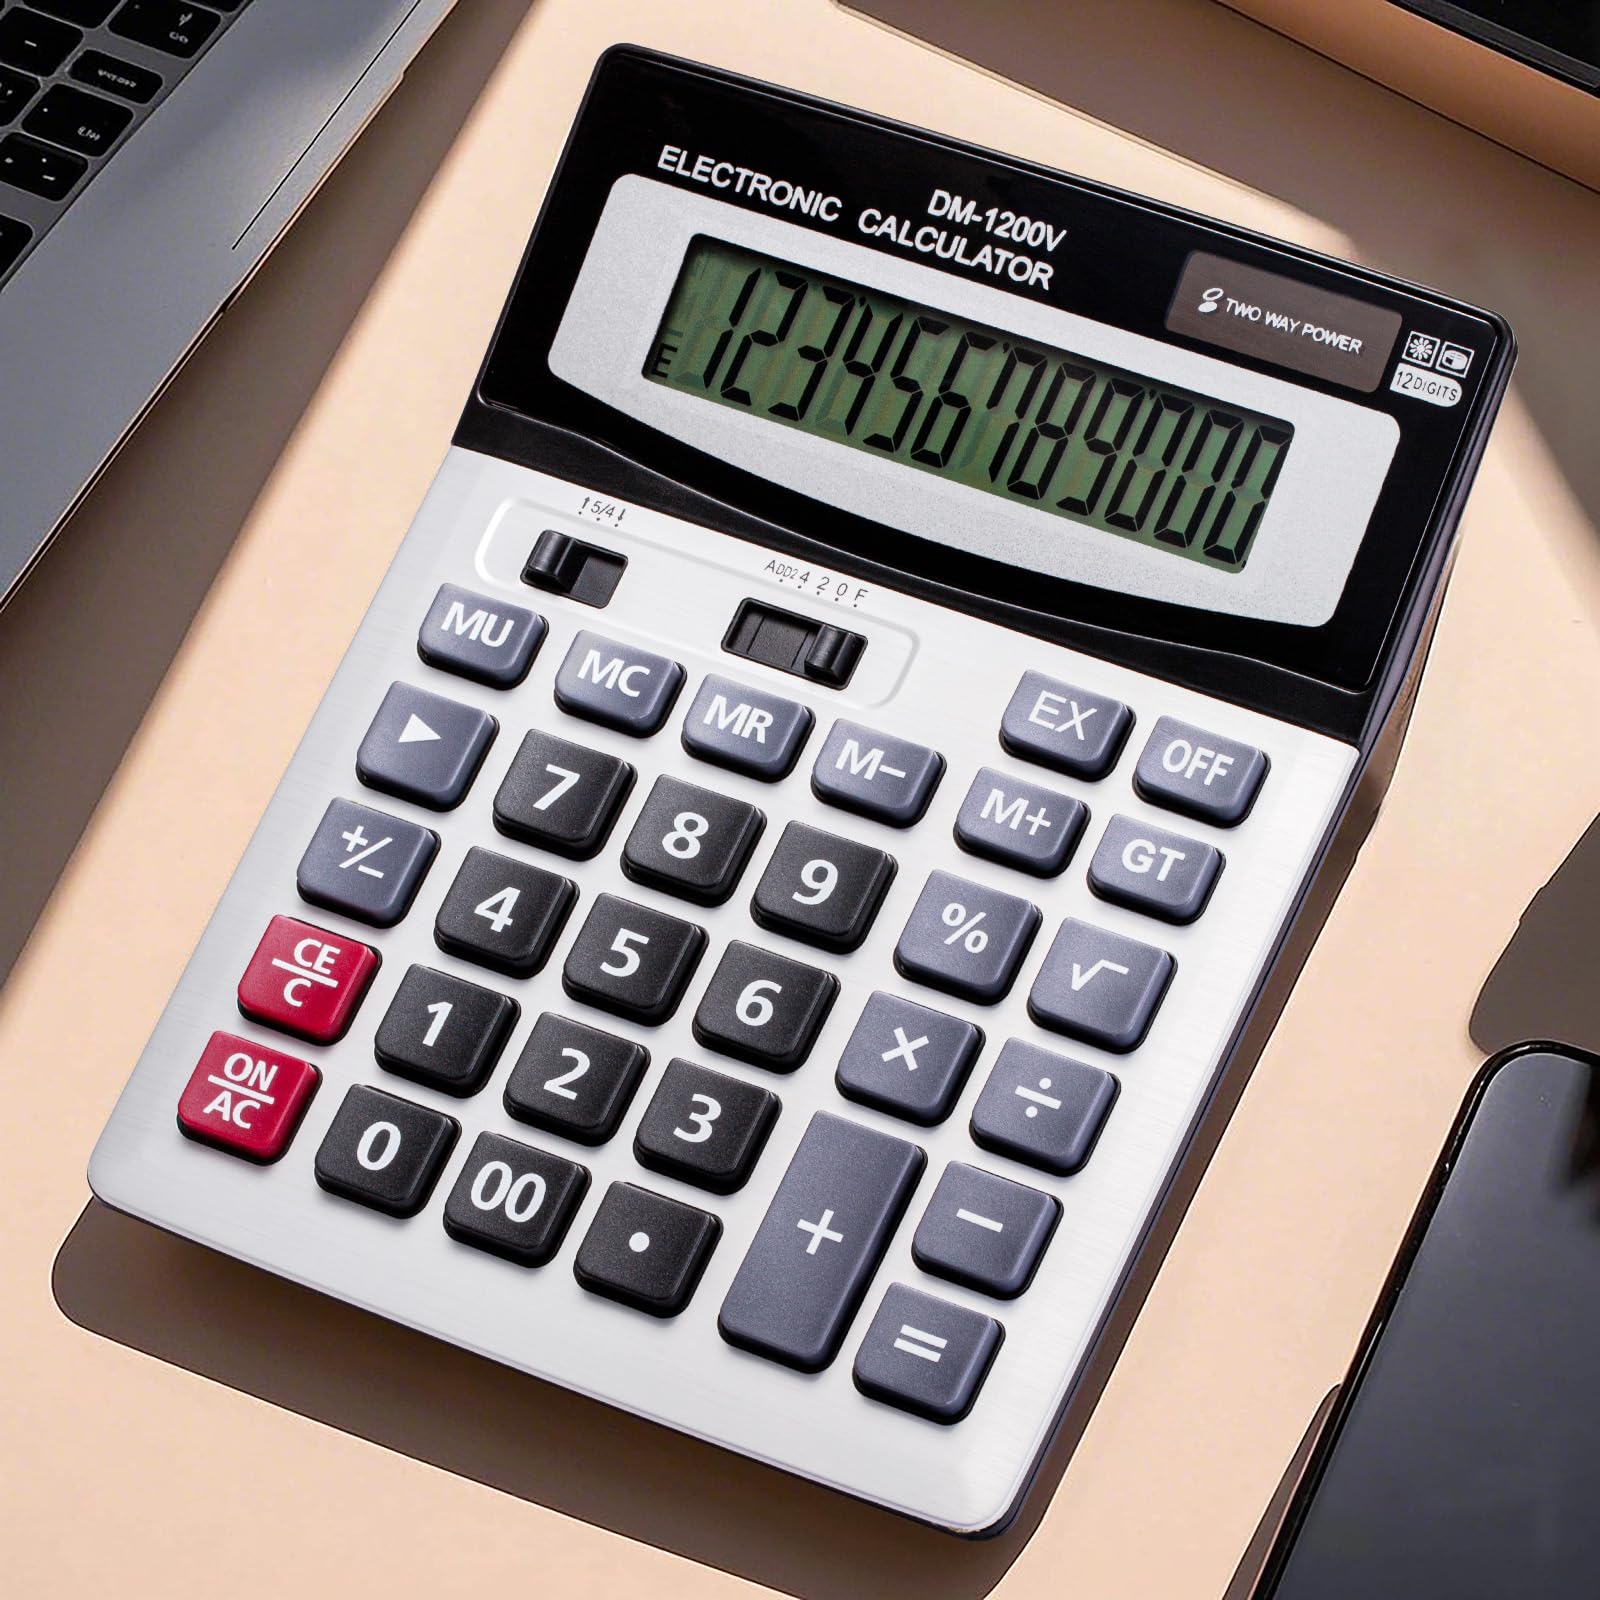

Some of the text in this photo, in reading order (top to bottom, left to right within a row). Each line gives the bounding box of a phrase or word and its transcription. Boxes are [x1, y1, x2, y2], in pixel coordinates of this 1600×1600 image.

[657, 144, 1055, 291] ELECTRONIC CALCULATOR
[927, 189, 1067, 252] DM-1200V
[1226, 298, 1363, 354] TWO WAY POWER
[440, 602, 515, 648] MU
[577, 649, 651, 698] MC
[703, 693, 774, 744] MR
[1028, 690, 1098, 742] EX
[1162, 738, 1235, 787] OFF
[532, 764, 581, 812] 7
[980, 787, 1052, 836] M+
[661, 811, 710, 859] 8
[1121, 837, 1187, 882] GT
[791, 859, 839, 906] 9
[474, 886, 522, 934] 4
[941, 902, 990, 955] %
[294, 938, 341, 974] CE
[599, 927, 648, 977] 5
[284, 977, 311, 1008] C
[735, 979, 783, 1027] 6
[422, 1001, 454, 1047] 1
[224, 1052, 279, 1091] ON
[543, 1047, 592, 1100] 2
[203, 1092, 261, 1130] AC
[673, 1093, 723, 1144] 3
[356, 1121, 403, 1172] 0
[470, 1160, 548, 1224] 00
